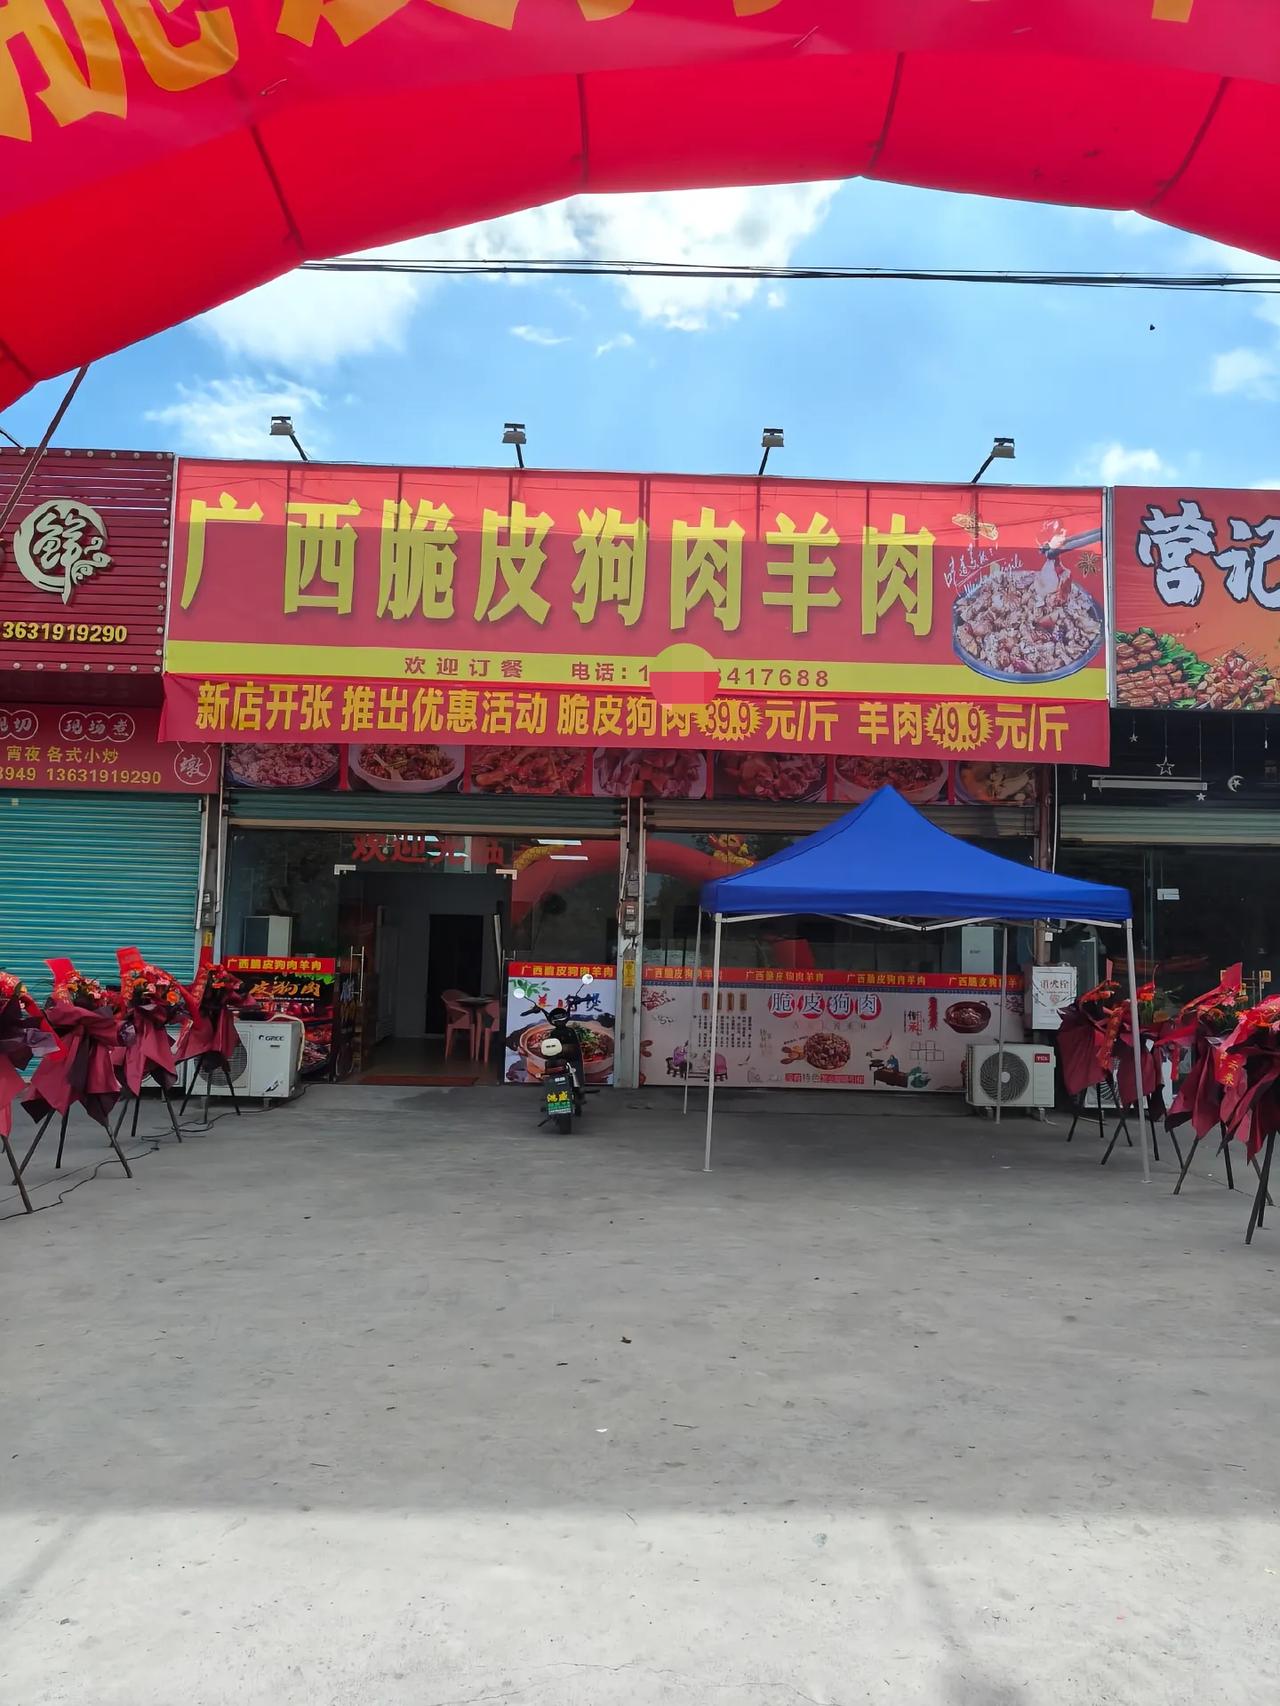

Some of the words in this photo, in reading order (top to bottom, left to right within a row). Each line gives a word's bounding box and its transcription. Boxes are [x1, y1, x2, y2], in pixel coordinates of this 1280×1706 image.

[180, 491, 936, 636] 广西脆皮狗肉羊肉
[2, 621, 127, 643] 3631919290
[404, 656, 523, 678] 欢迎订餐
[195, 681, 331, 731] 新店开张
[341, 683, 547, 735] 推出优惠活动
[64, 718, 129, 736] 现场煮
[7, 745, 41, 761] 宵夜
[47, 747, 119, 765] 各式小炒
[46, 767, 161, 784] 13631919290
[770, 991, 879, 1016] 脆皮狗肉
